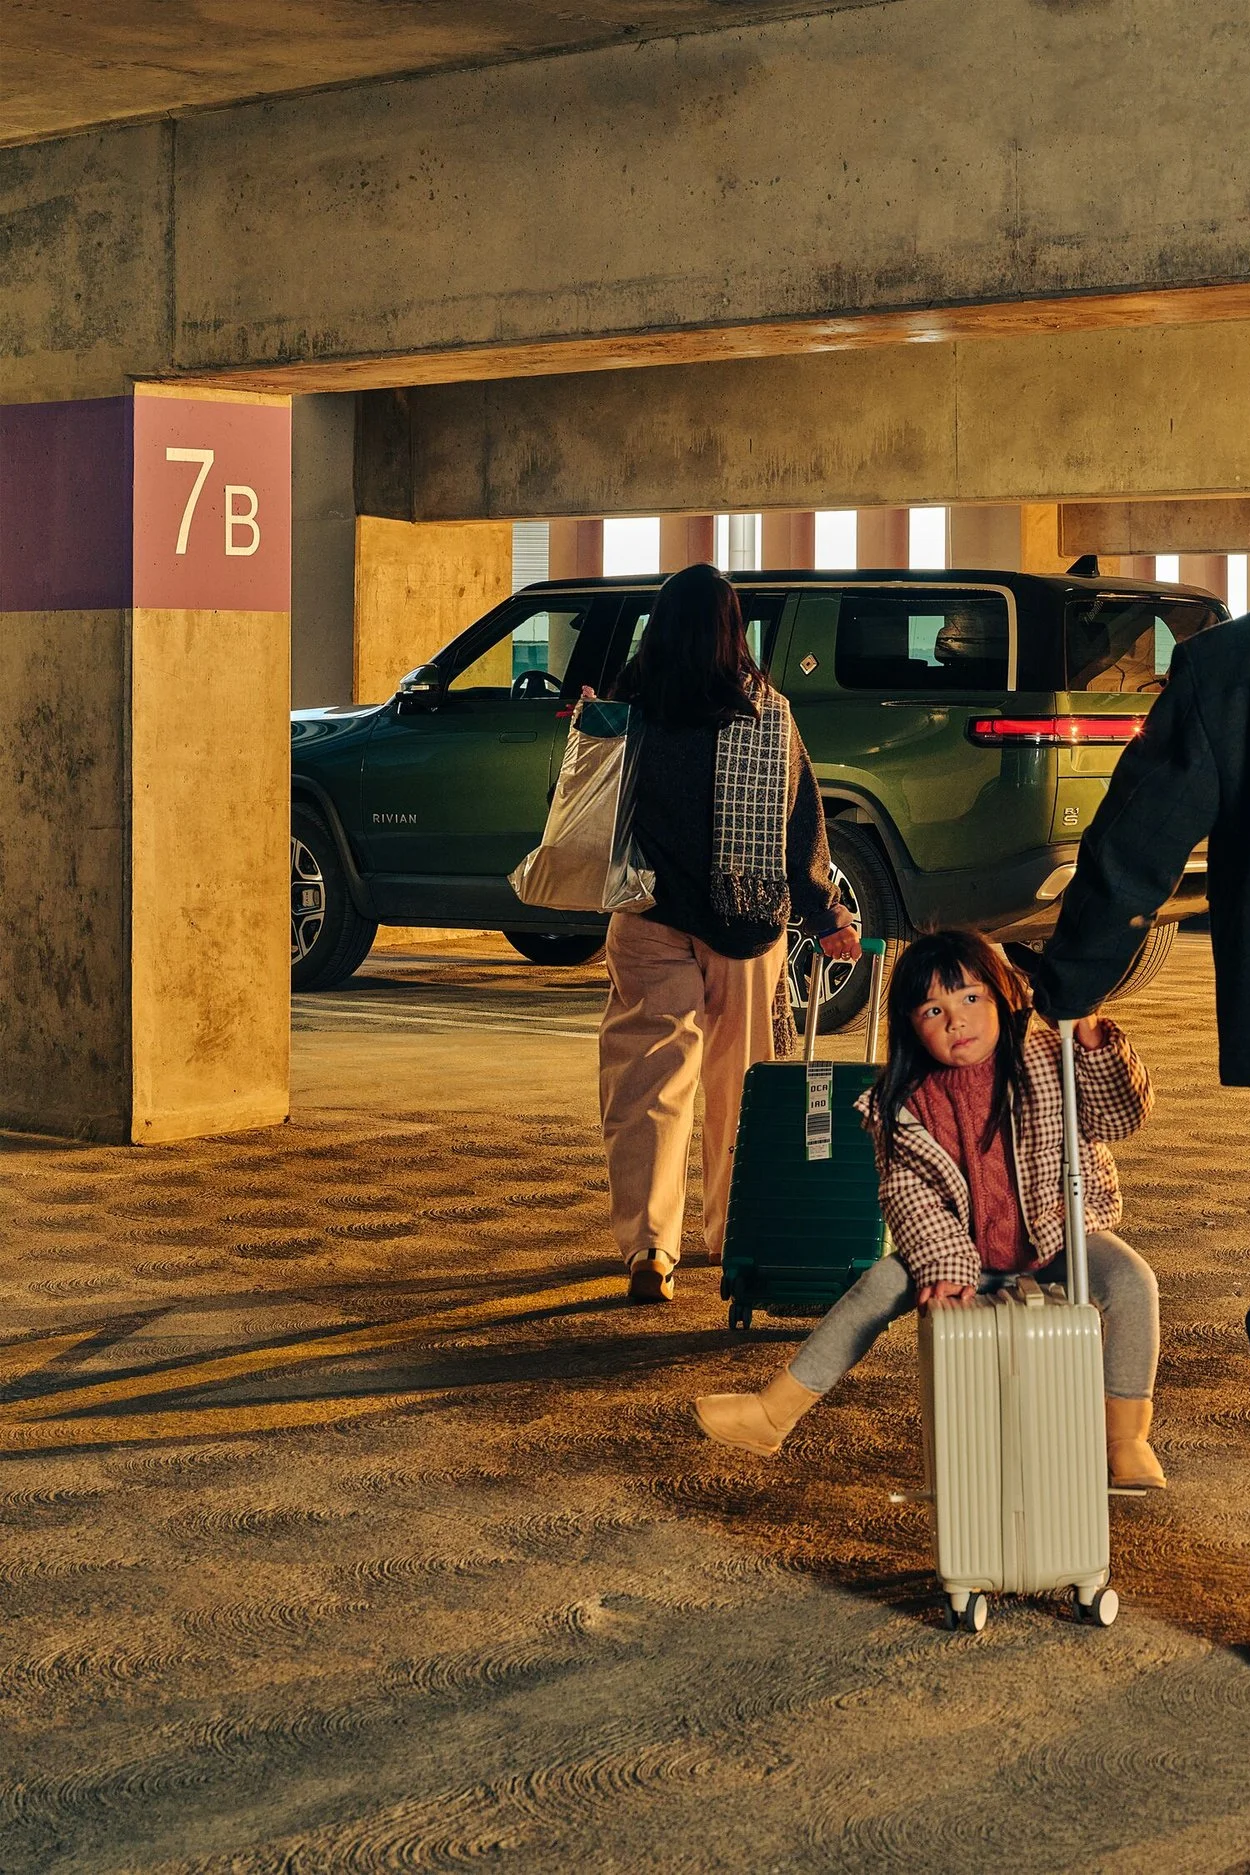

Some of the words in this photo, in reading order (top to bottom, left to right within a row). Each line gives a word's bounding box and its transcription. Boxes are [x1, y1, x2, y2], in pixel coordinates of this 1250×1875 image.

[372, 813, 417, 824] RIVIAN
[810, 1084, 828, 1093] DCA
[810, 1100, 826, 1109] IAD
